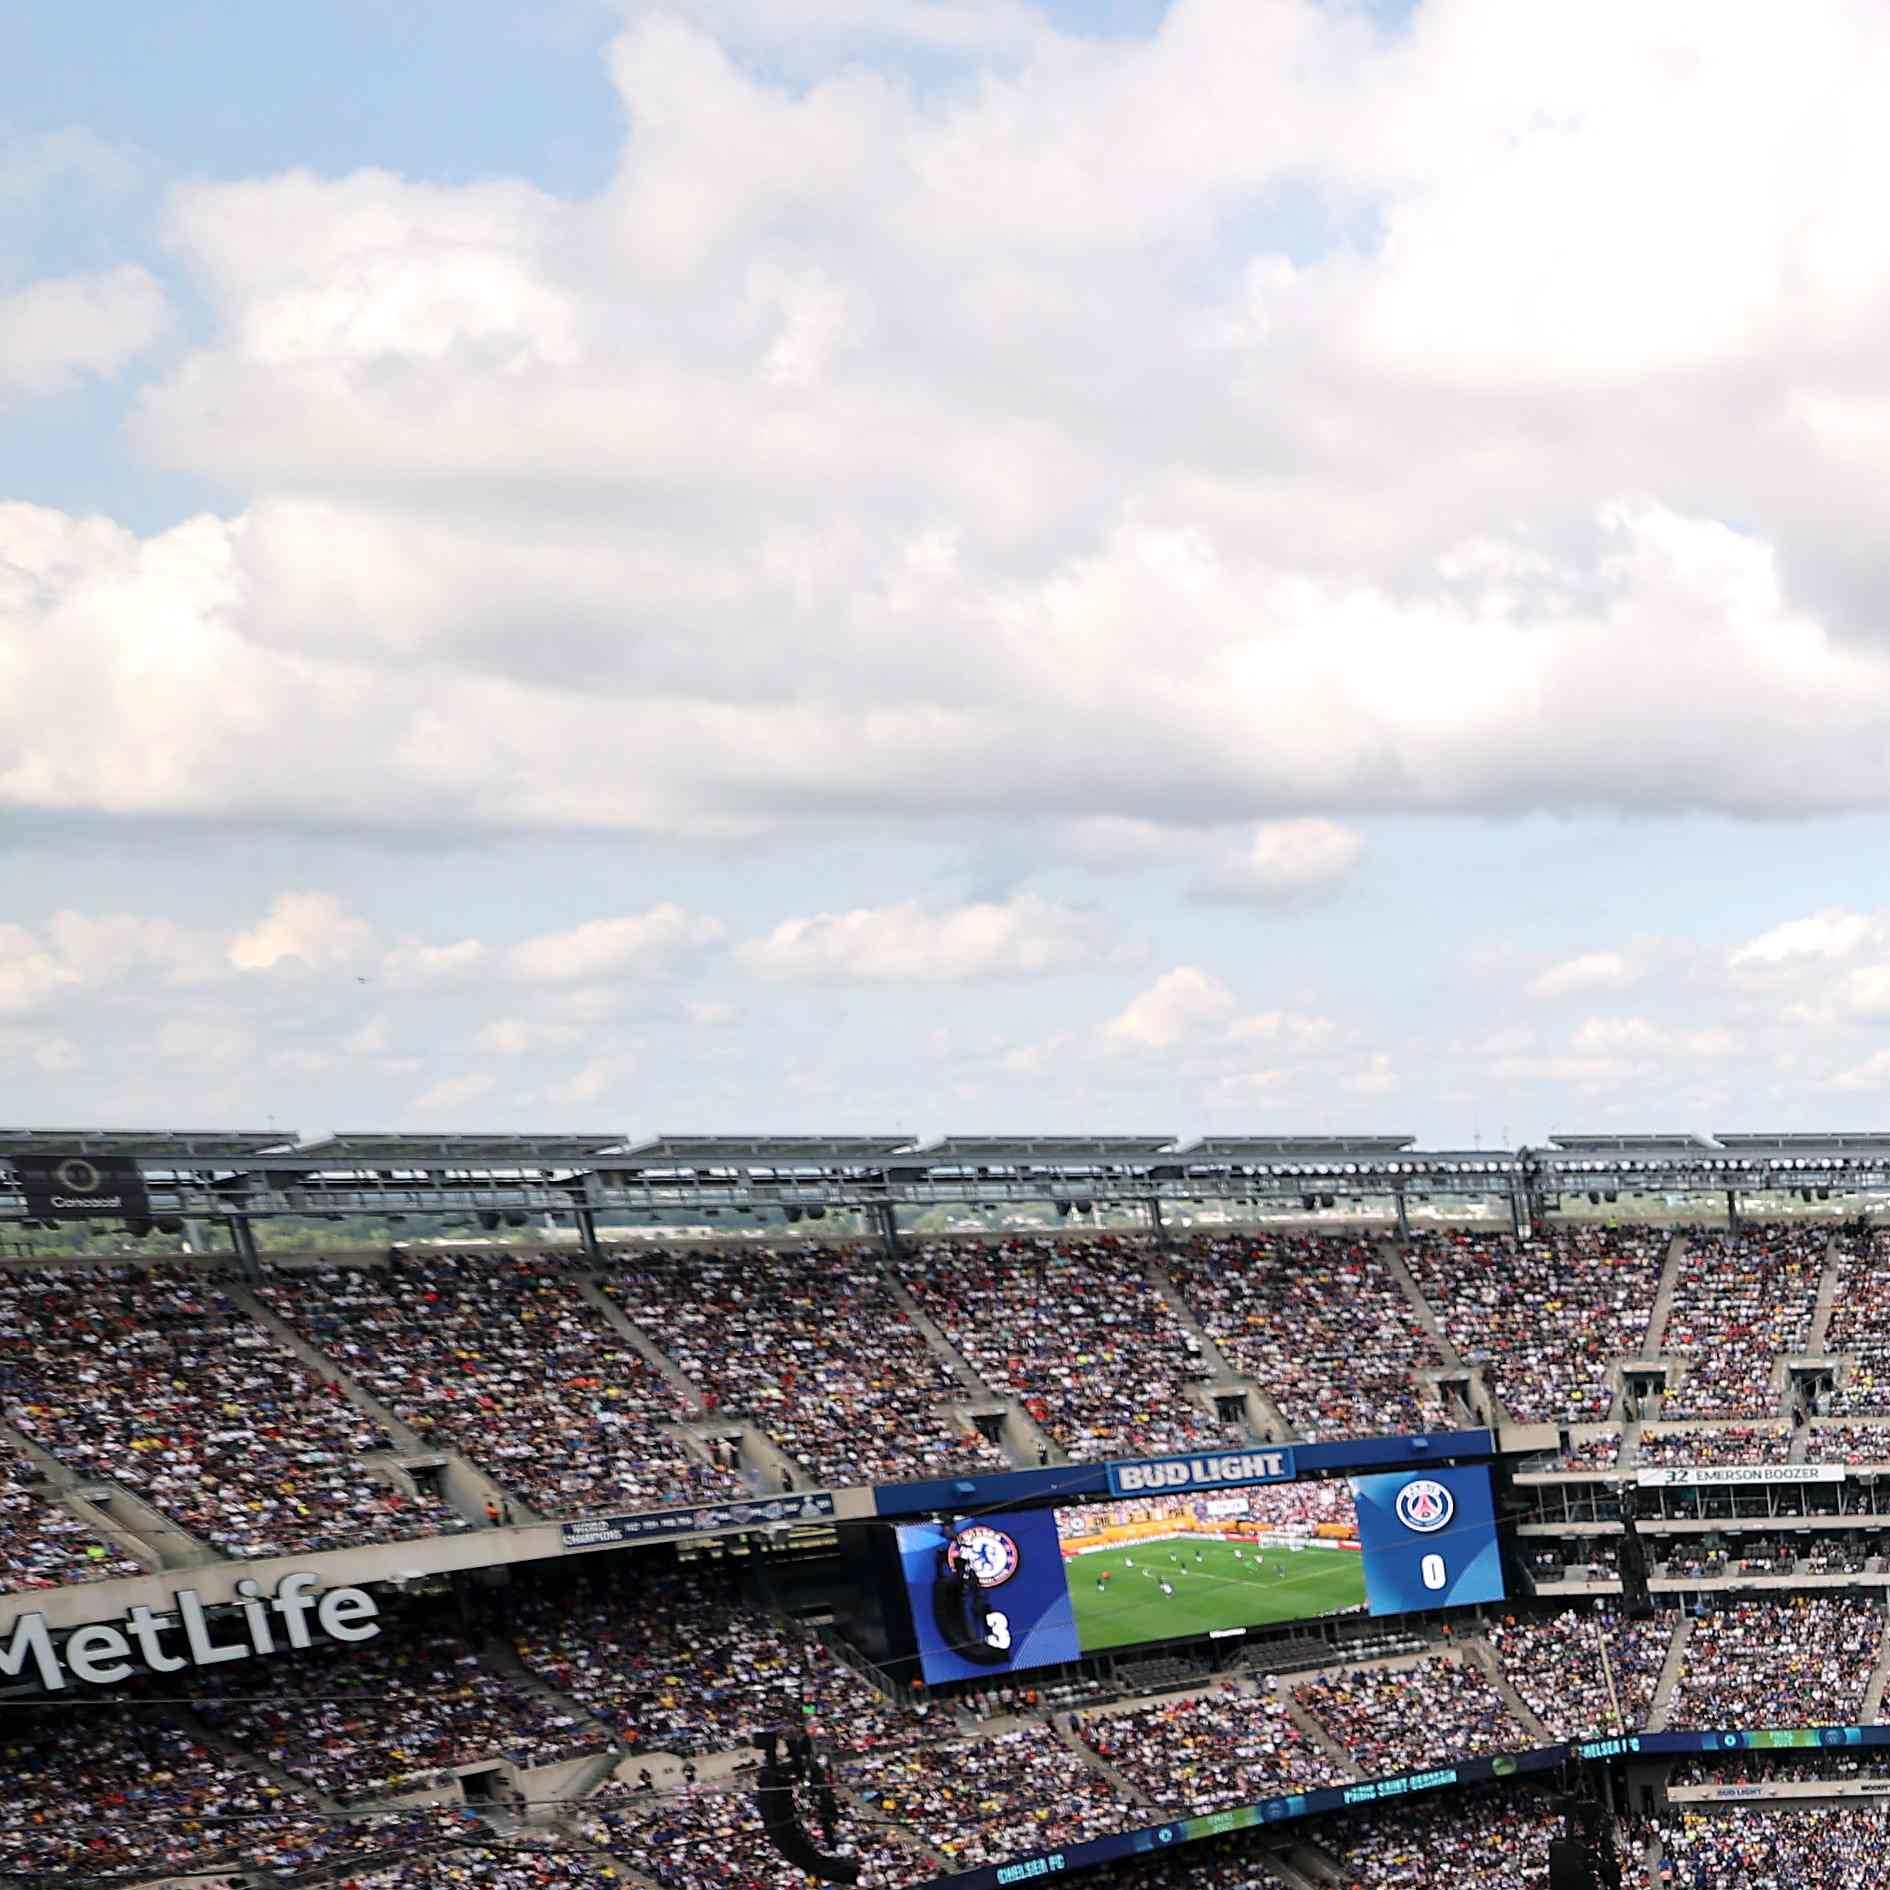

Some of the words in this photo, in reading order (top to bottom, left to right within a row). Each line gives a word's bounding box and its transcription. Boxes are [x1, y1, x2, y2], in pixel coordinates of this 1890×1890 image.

[1119, 1463, 1190, 1491] BUD
[1193, 1453, 1285, 1484] LIGHT
[1665, 1469, 1688, 1482] 32
[1696, 1469, 1761, 1481] EMERSON
[1765, 1468, 1819, 1480] BOOZER
[1420, 1554, 1446, 1589] 0
[0, 1573, 382, 1690] MetLife
[985, 1611, 1011, 1649] 3
